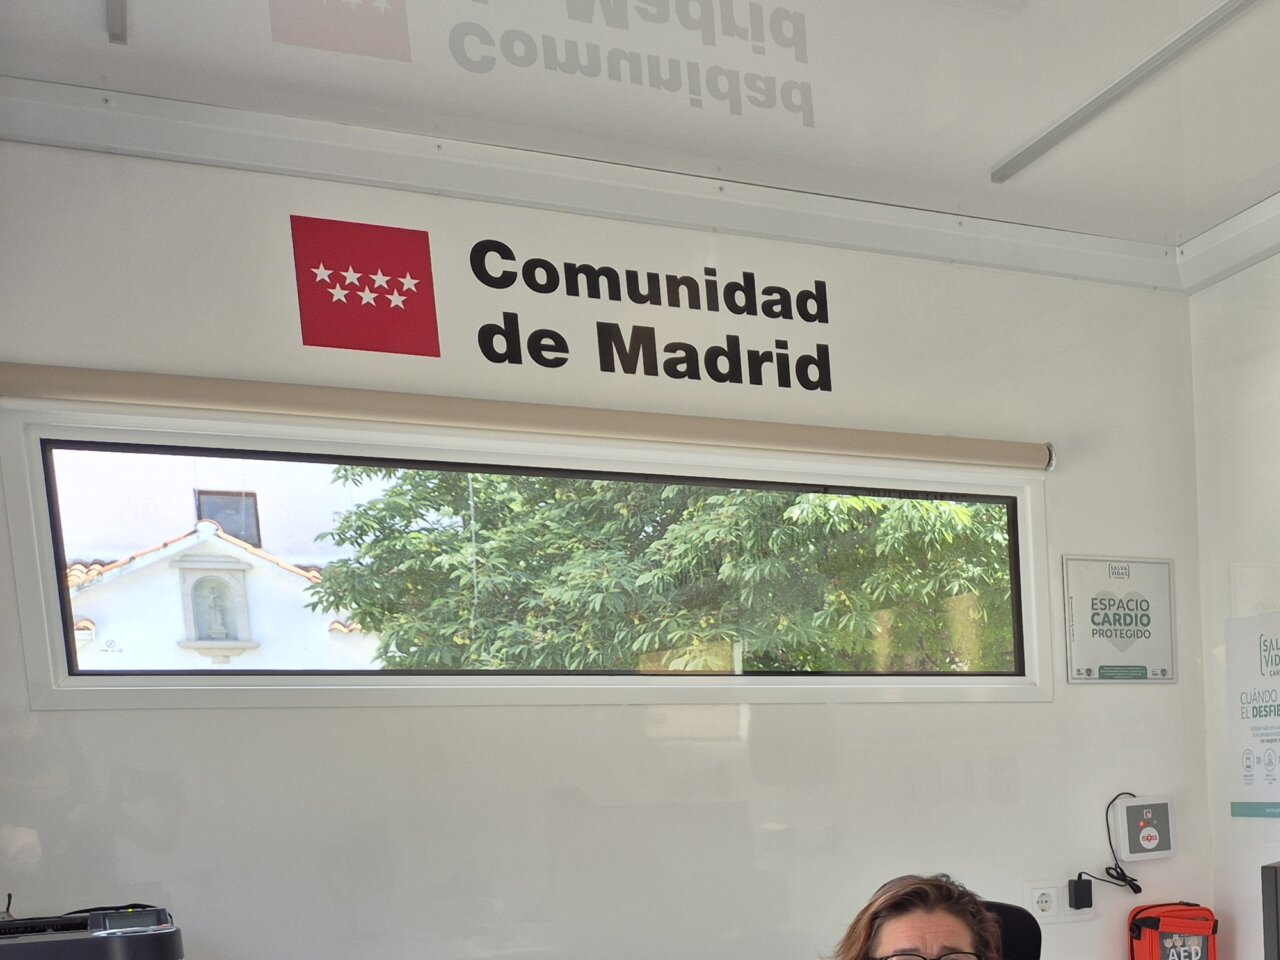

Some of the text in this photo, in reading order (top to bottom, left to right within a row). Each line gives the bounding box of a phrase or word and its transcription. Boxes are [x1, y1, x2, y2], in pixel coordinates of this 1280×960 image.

[469, 239, 829, 323] Comunidad
[477, 311, 832, 392] de Madrid
[1091, 597, 1150, 612] ESPACIO
[1091, 612, 1151, 627] CARDIO
[1092, 628, 1151, 639] PROTEGIDO
[1240, 687, 1278, 705] CUÁNDO
[1241, 706, 1251, 719] EL
